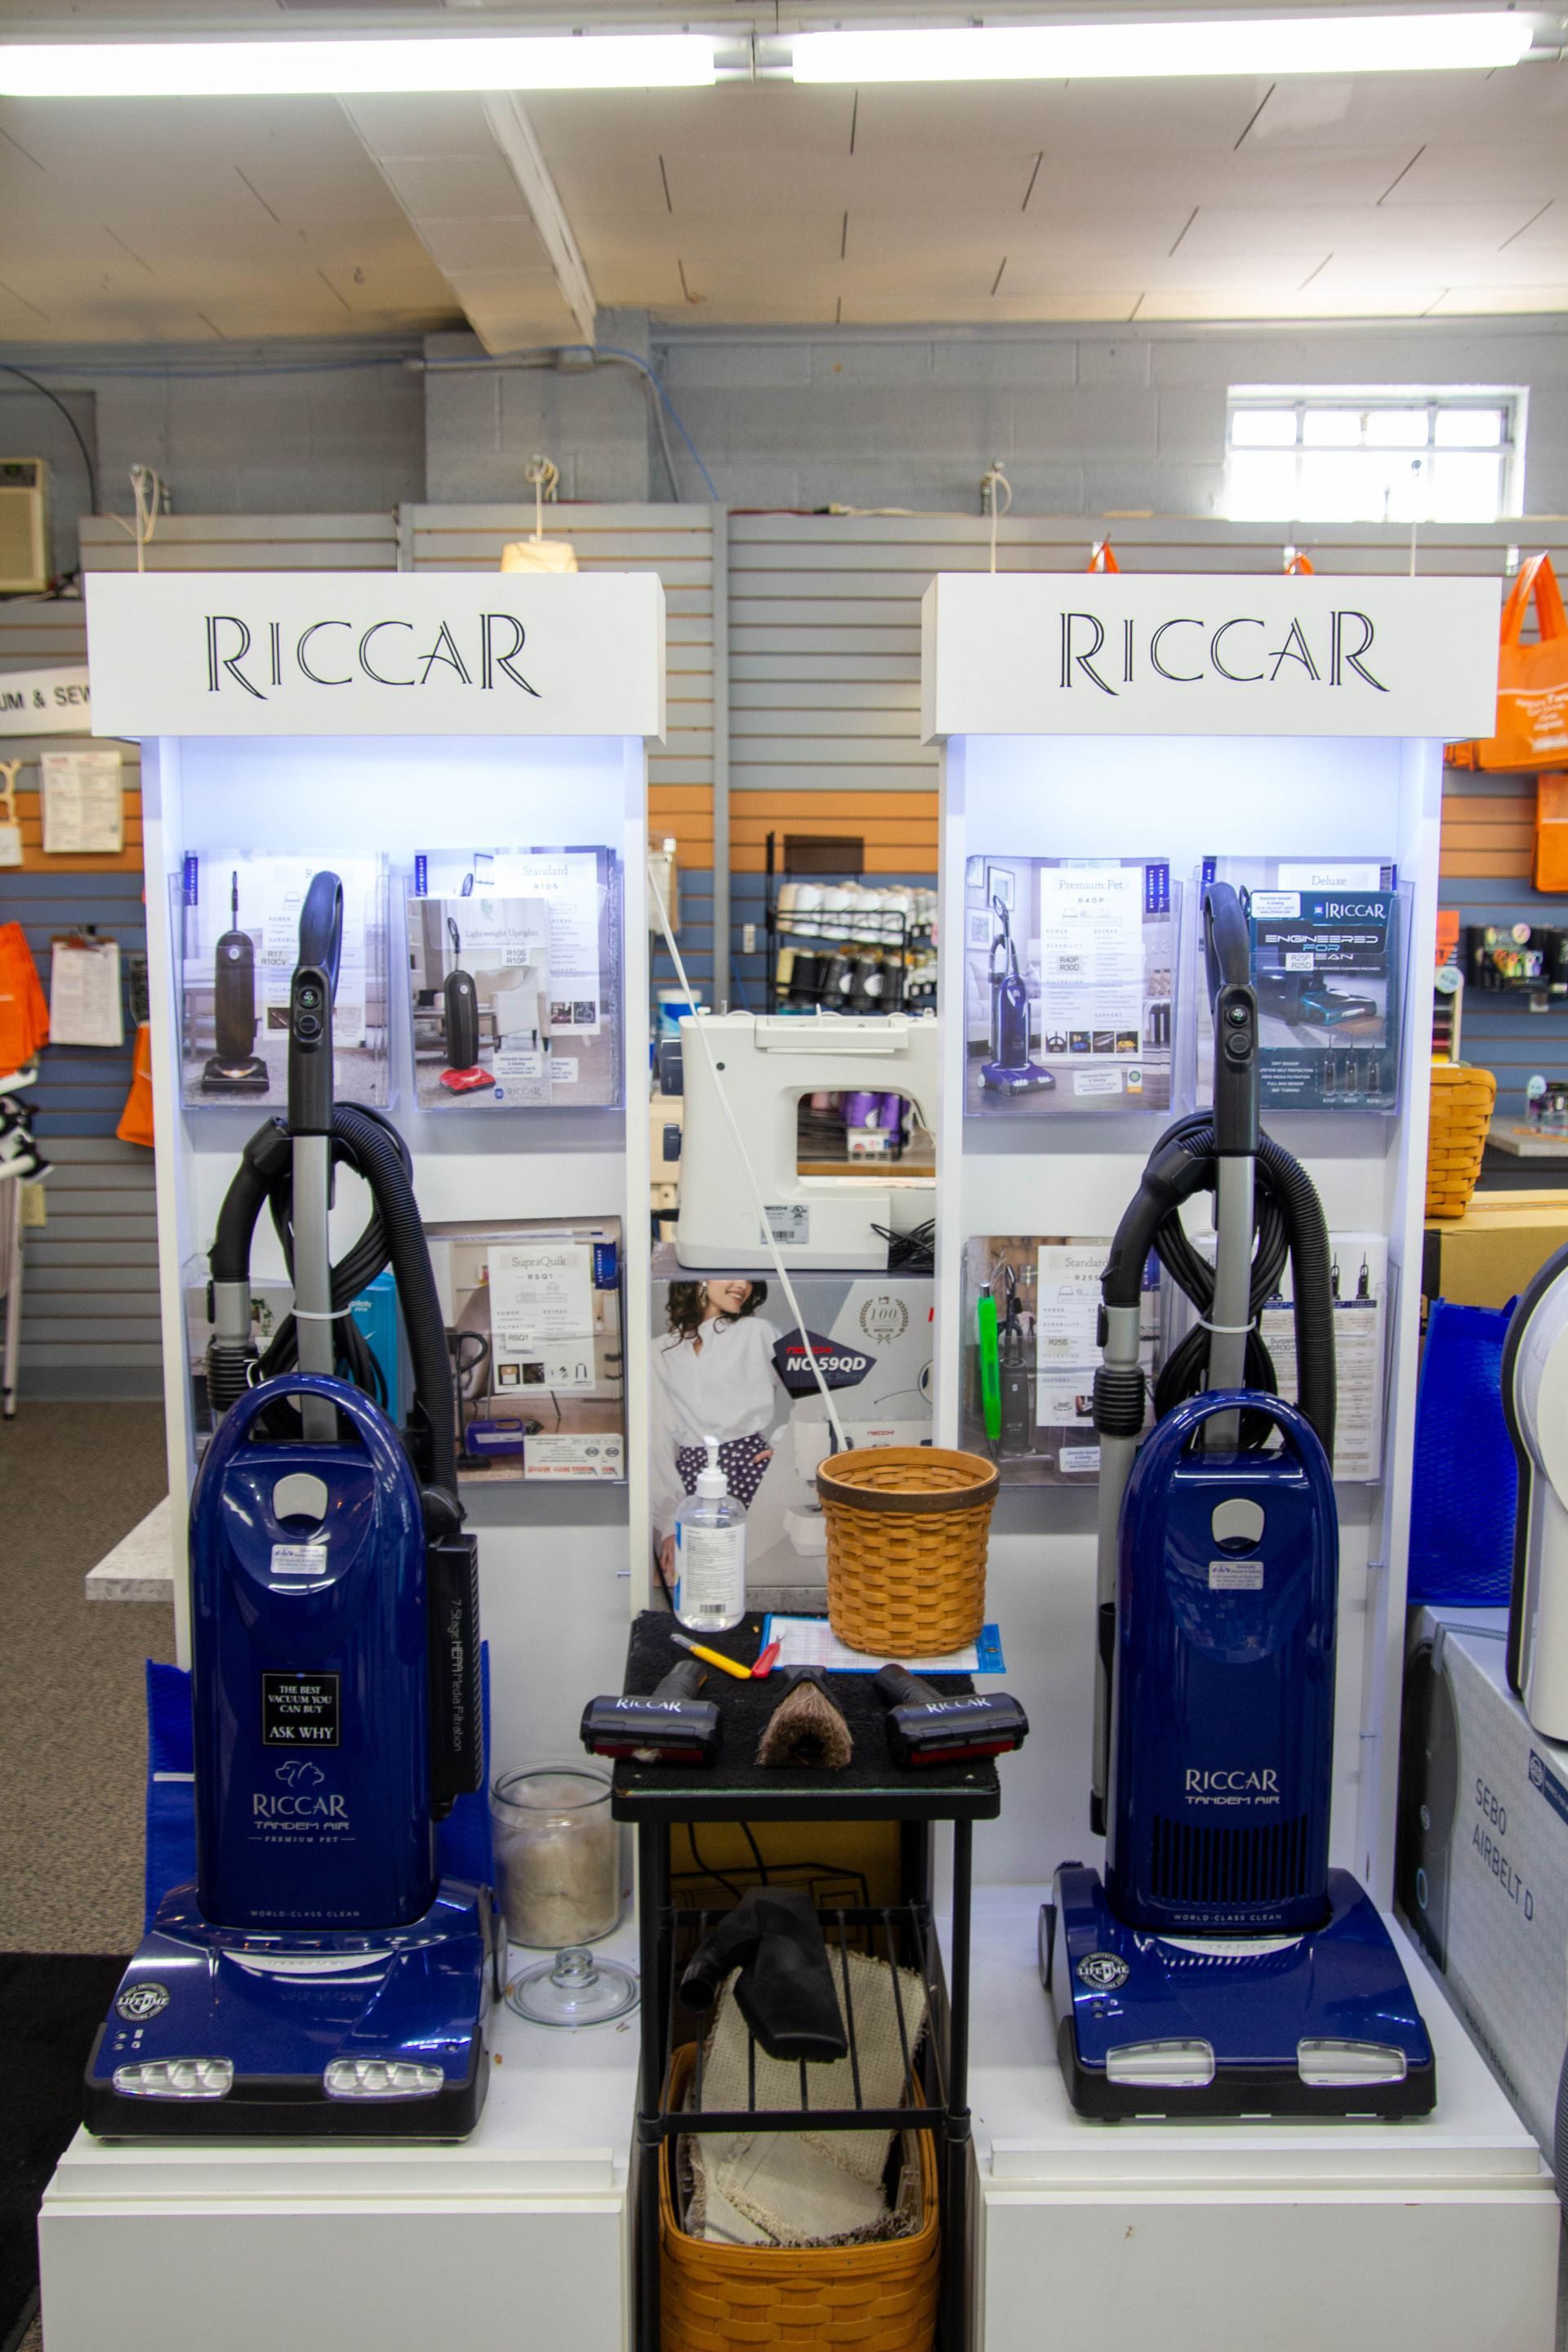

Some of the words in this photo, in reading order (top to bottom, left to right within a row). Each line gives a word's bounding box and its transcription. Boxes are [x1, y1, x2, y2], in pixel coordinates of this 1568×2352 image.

[203, 613, 542, 700] RICCAR
[1058, 611, 1391, 697] RICCAR
[33, 689, 46, 709] &
[523, 865, 568, 876] Standard
[1058, 880, 1103, 889] Premium
[1107, 880, 1123, 889] Pet
[1312, 875, 1347, 885] Deluxe
[1330, 902, 1387, 919] RICCAR
[466, 929, 506, 938] Lightweight
[509, 929, 539, 938] Uprights
[1265, 935, 1379, 943] ENGINEERED
[506, 1088, 542, 1097] RICCAR
[511, 1255, 567, 1269] SupraQuik
[871, 1308, 898, 1320] 100
[451, 1641, 463, 1673] HEPA
[279, 1686, 298, 1694] THE
[300, 1686, 322, 1695] BEST
[268, 1695, 310, 1704] VACUUM
[311, 1695, 332, 1704] YOU
[925, 1698, 992, 1713] RICCAR
[303, 1705, 323, 1713] BUY
[616, 1699, 682, 1713] RICCAR
[269, 1725, 296, 1739] ASK
[298, 1726, 334, 1740] WHY
[452, 1706, 464, 1752] Filtration
[1186, 1769, 1280, 1793] RICCAR
[252, 1793, 349, 1819] RICCAR
[1185, 1796, 1250, 1805] TANDEM
[1254, 1796, 1281, 1804] AIR
[1475, 1778, 1507, 1836] SEBO
[253, 1821, 319, 1830] TANDEM
[323, 1822, 350, 1830] AIR
[1472, 1822, 1522, 1905] AIRBELT
[1524, 1888, 1534, 1922] D
[250, 1909, 322, 1918] WORLD-CLASS
[1078, 1966, 1129, 1975] LIFETIME
[118, 1997, 170, 2006] LIFETIME
